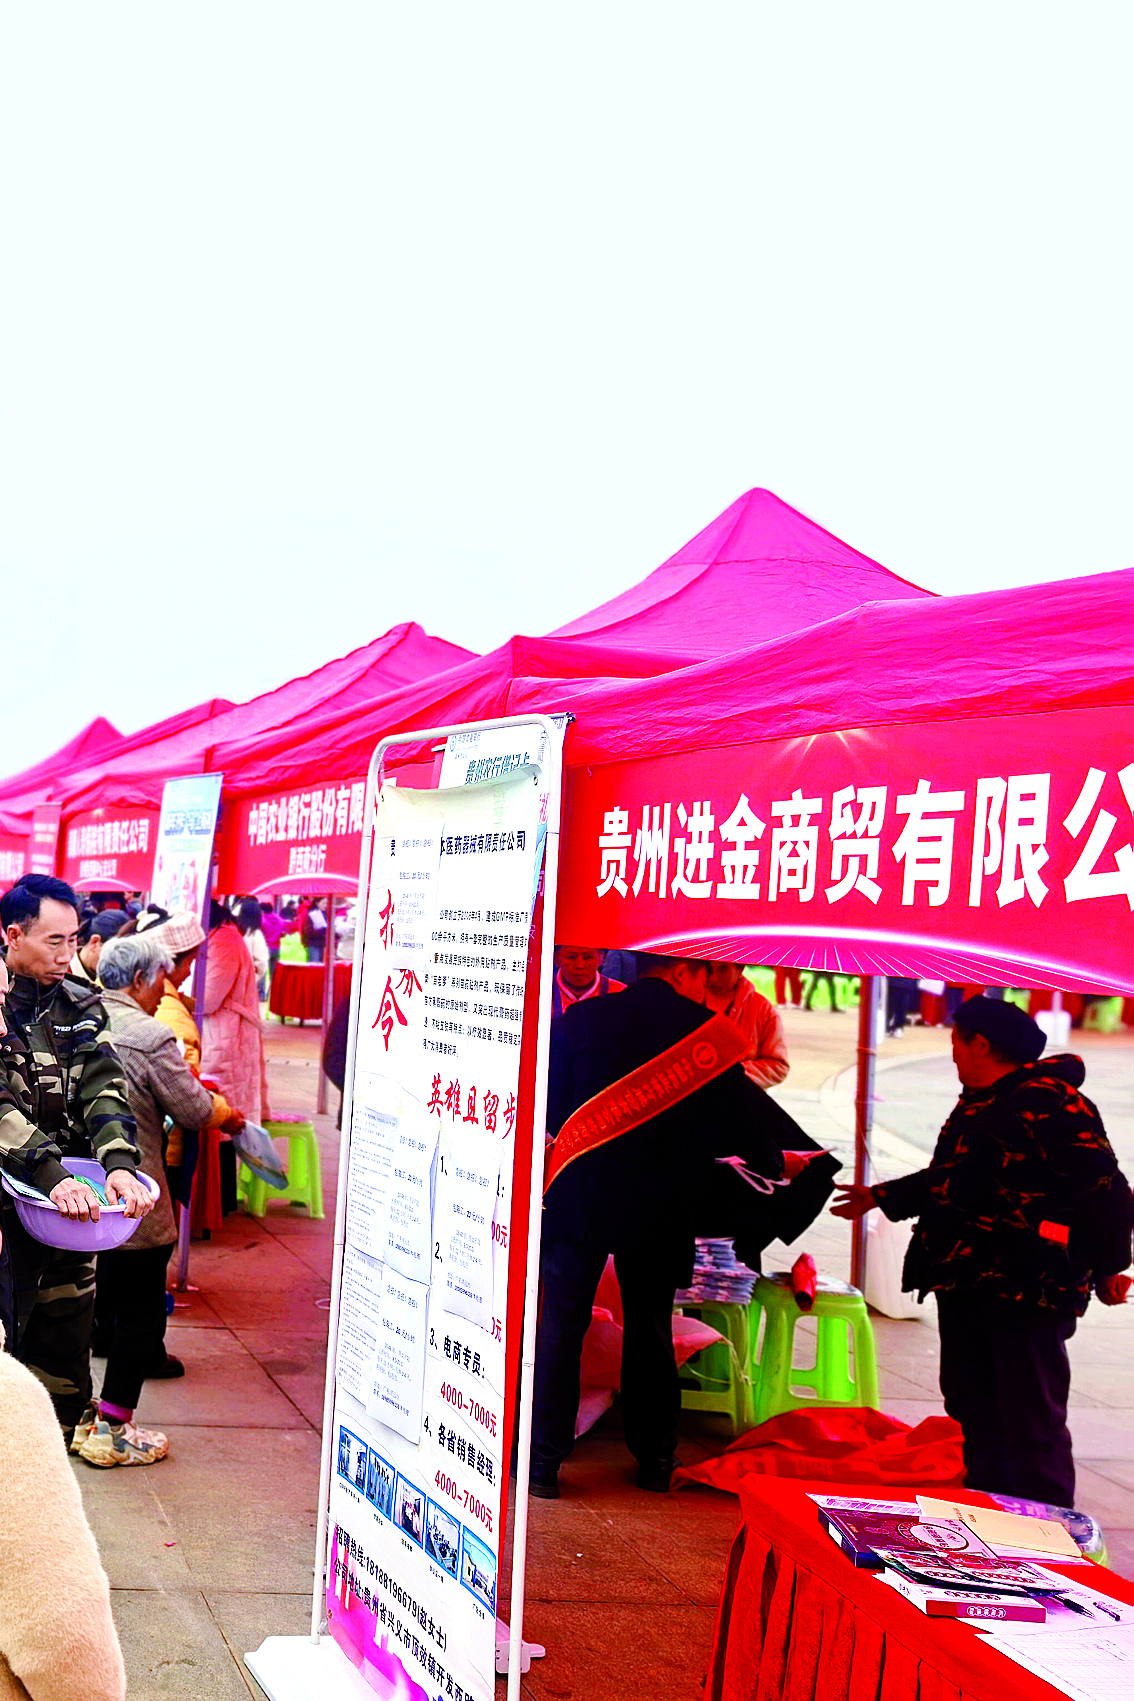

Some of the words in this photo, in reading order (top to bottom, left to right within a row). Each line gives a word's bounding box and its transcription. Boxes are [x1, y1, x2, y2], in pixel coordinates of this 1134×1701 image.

[248, 782, 365, 846] 中国农业银行股份有限
[596, 764, 1134, 912] 贵州进金商贸有限公
[426, 1072, 516, 1139] 英雄且留步
[440, 1382, 497, 1438] 4000-7000元
[434, 1470, 493, 1533] 4000-7000元
